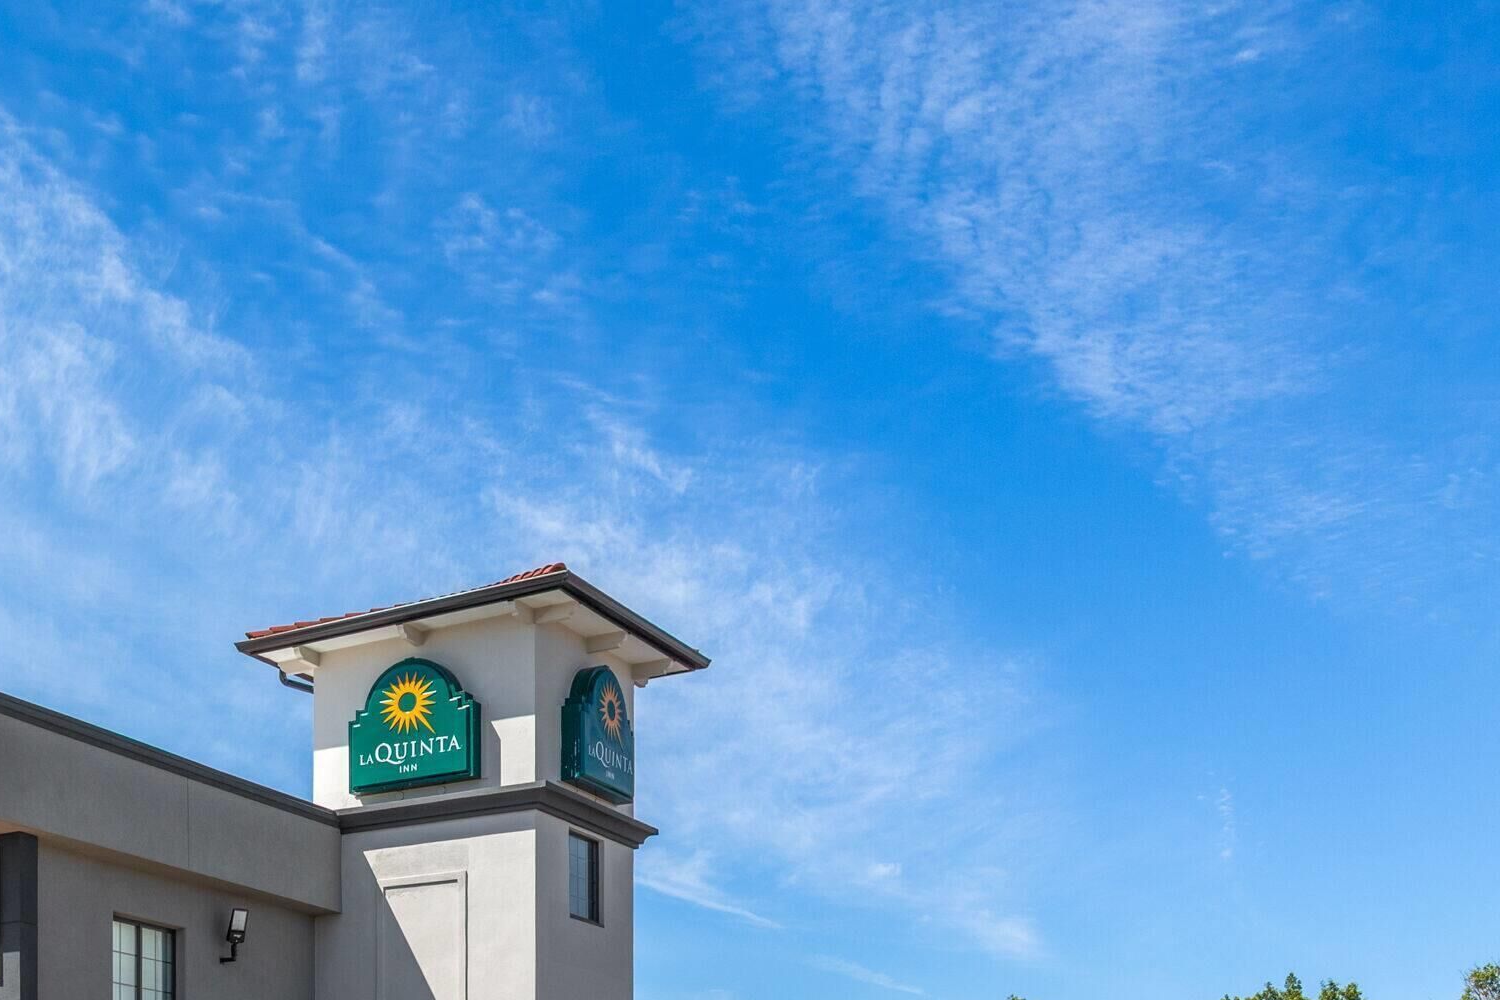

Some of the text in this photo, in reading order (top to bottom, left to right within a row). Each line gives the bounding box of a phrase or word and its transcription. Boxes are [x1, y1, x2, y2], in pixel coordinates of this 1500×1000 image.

[359, 734, 461, 766] LA QUINTA
[595, 741, 633, 776] QUINTA
[399, 763, 418, 773] INN
